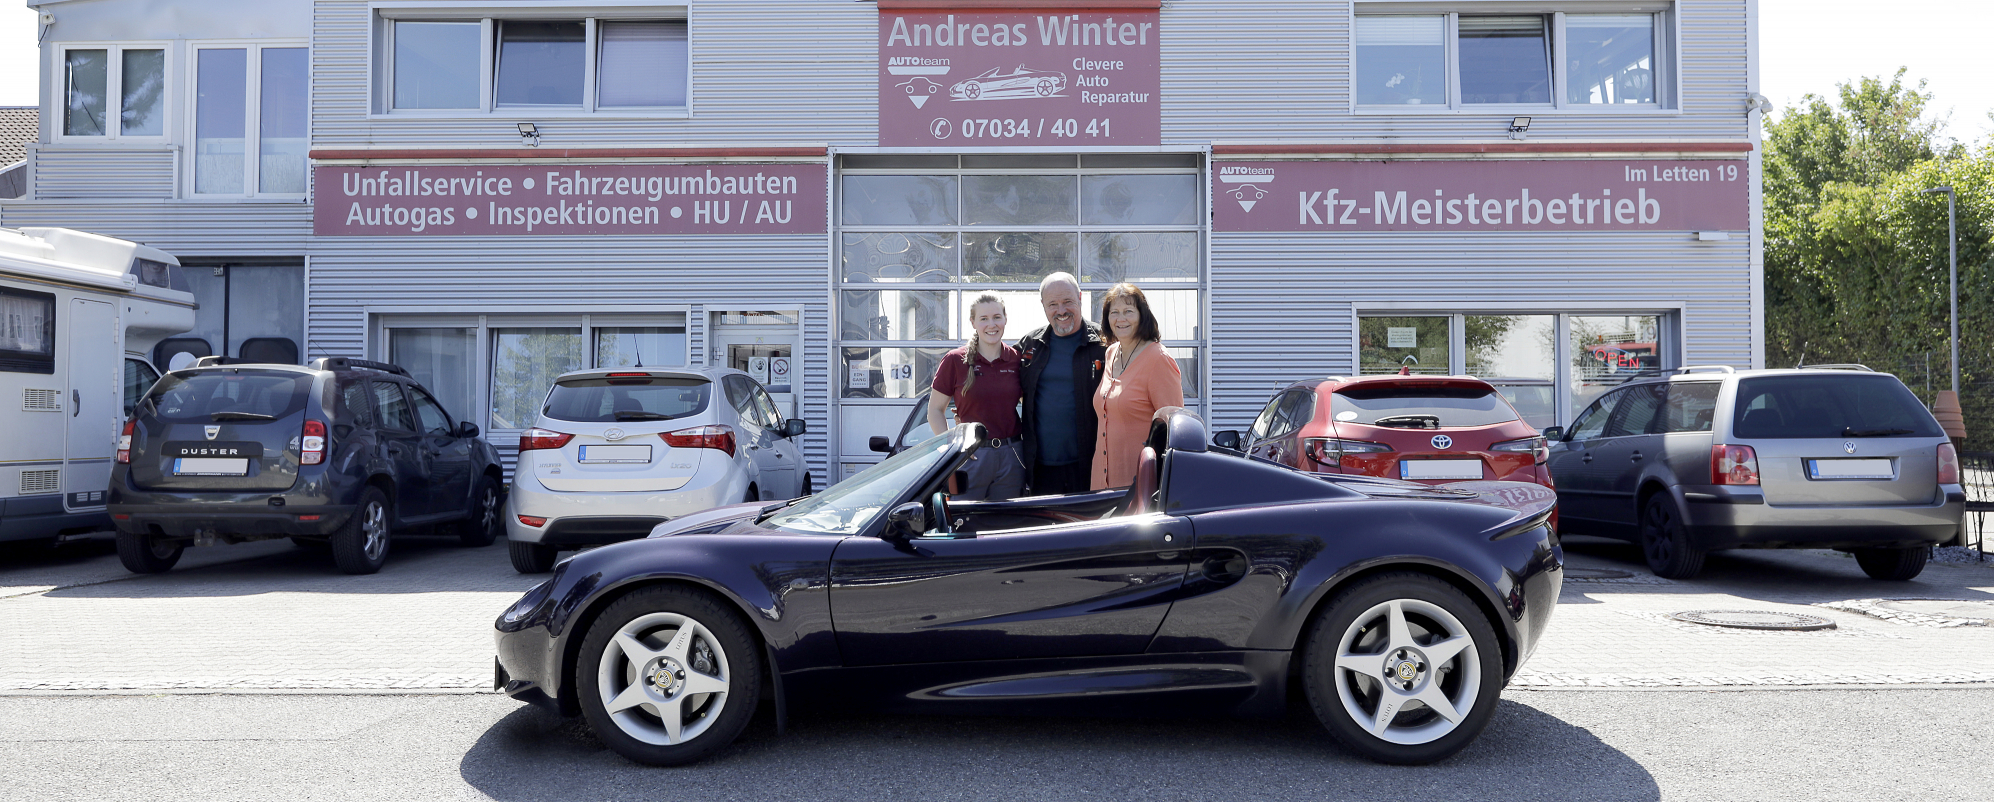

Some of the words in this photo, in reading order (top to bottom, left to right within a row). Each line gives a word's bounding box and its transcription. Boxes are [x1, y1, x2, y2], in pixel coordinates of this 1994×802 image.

[887, 14, 1027, 47] Andreas
[1037, 14, 1152, 46] Winter
[888, 56, 950, 66] AUTOteam
[1072, 57, 1124, 71] Clevere
[1075, 74, 1109, 87] Auto
[1081, 91, 1150, 107] Reparatur
[961, 118, 1031, 138] 07034
[1050, 118, 1078, 138] 40
[1085, 118, 1110, 138] 41
[1219, 166, 1275, 175] AUTOteam
[1625, 165, 1647, 182] Im
[1653, 165, 1710, 182] Letten
[1716, 165, 1738, 182] 19
[343, 171, 513, 197] Unfallservice
[546, 170, 797, 202] Fahrzeugumbauten
[1299, 188, 1661, 225] Kfz-Meisterbetrieb
[345, 201, 455, 232] Autogas
[489, 200, 660, 232] Inspektionen
[694, 201, 730, 225] HU
[755, 200, 792, 224] AU
[1595, 349, 1640, 369] OPEN
[891, 364, 912, 380] 19
